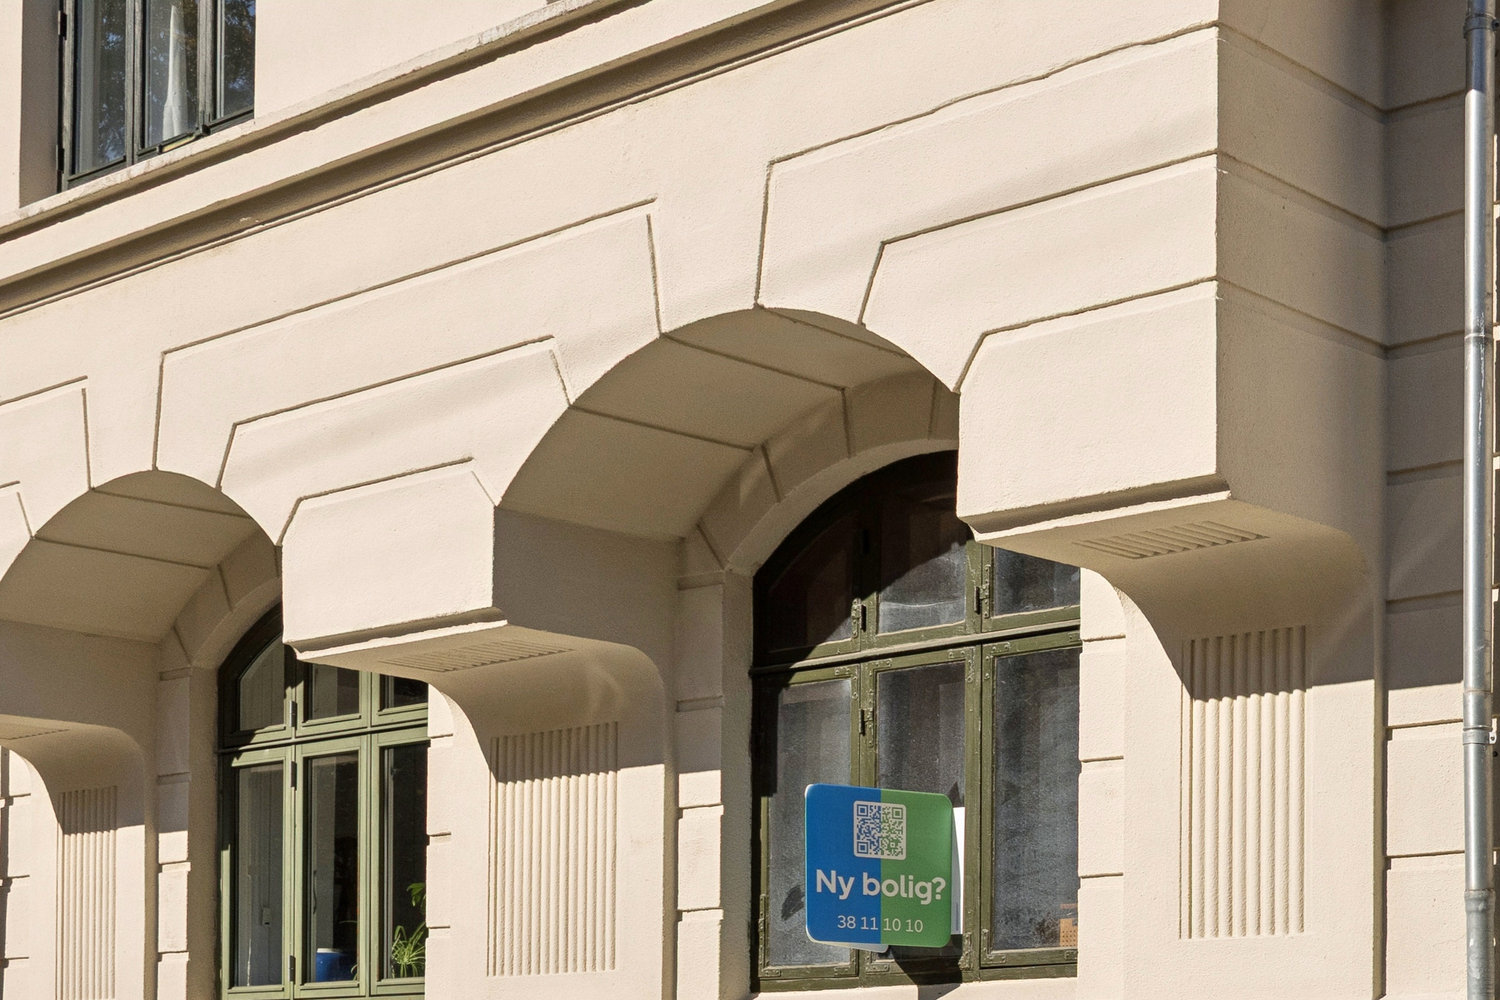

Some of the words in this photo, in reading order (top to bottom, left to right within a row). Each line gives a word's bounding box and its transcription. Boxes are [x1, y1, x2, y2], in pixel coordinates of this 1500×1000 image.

[816, 869, 855, 900] Ny
[862, 872, 946, 905] bolig?
[837, 915, 856, 929] 38
[860, 916, 878, 930] 11
[883, 918, 901, 931] 10
[905, 919, 924, 933] 10
